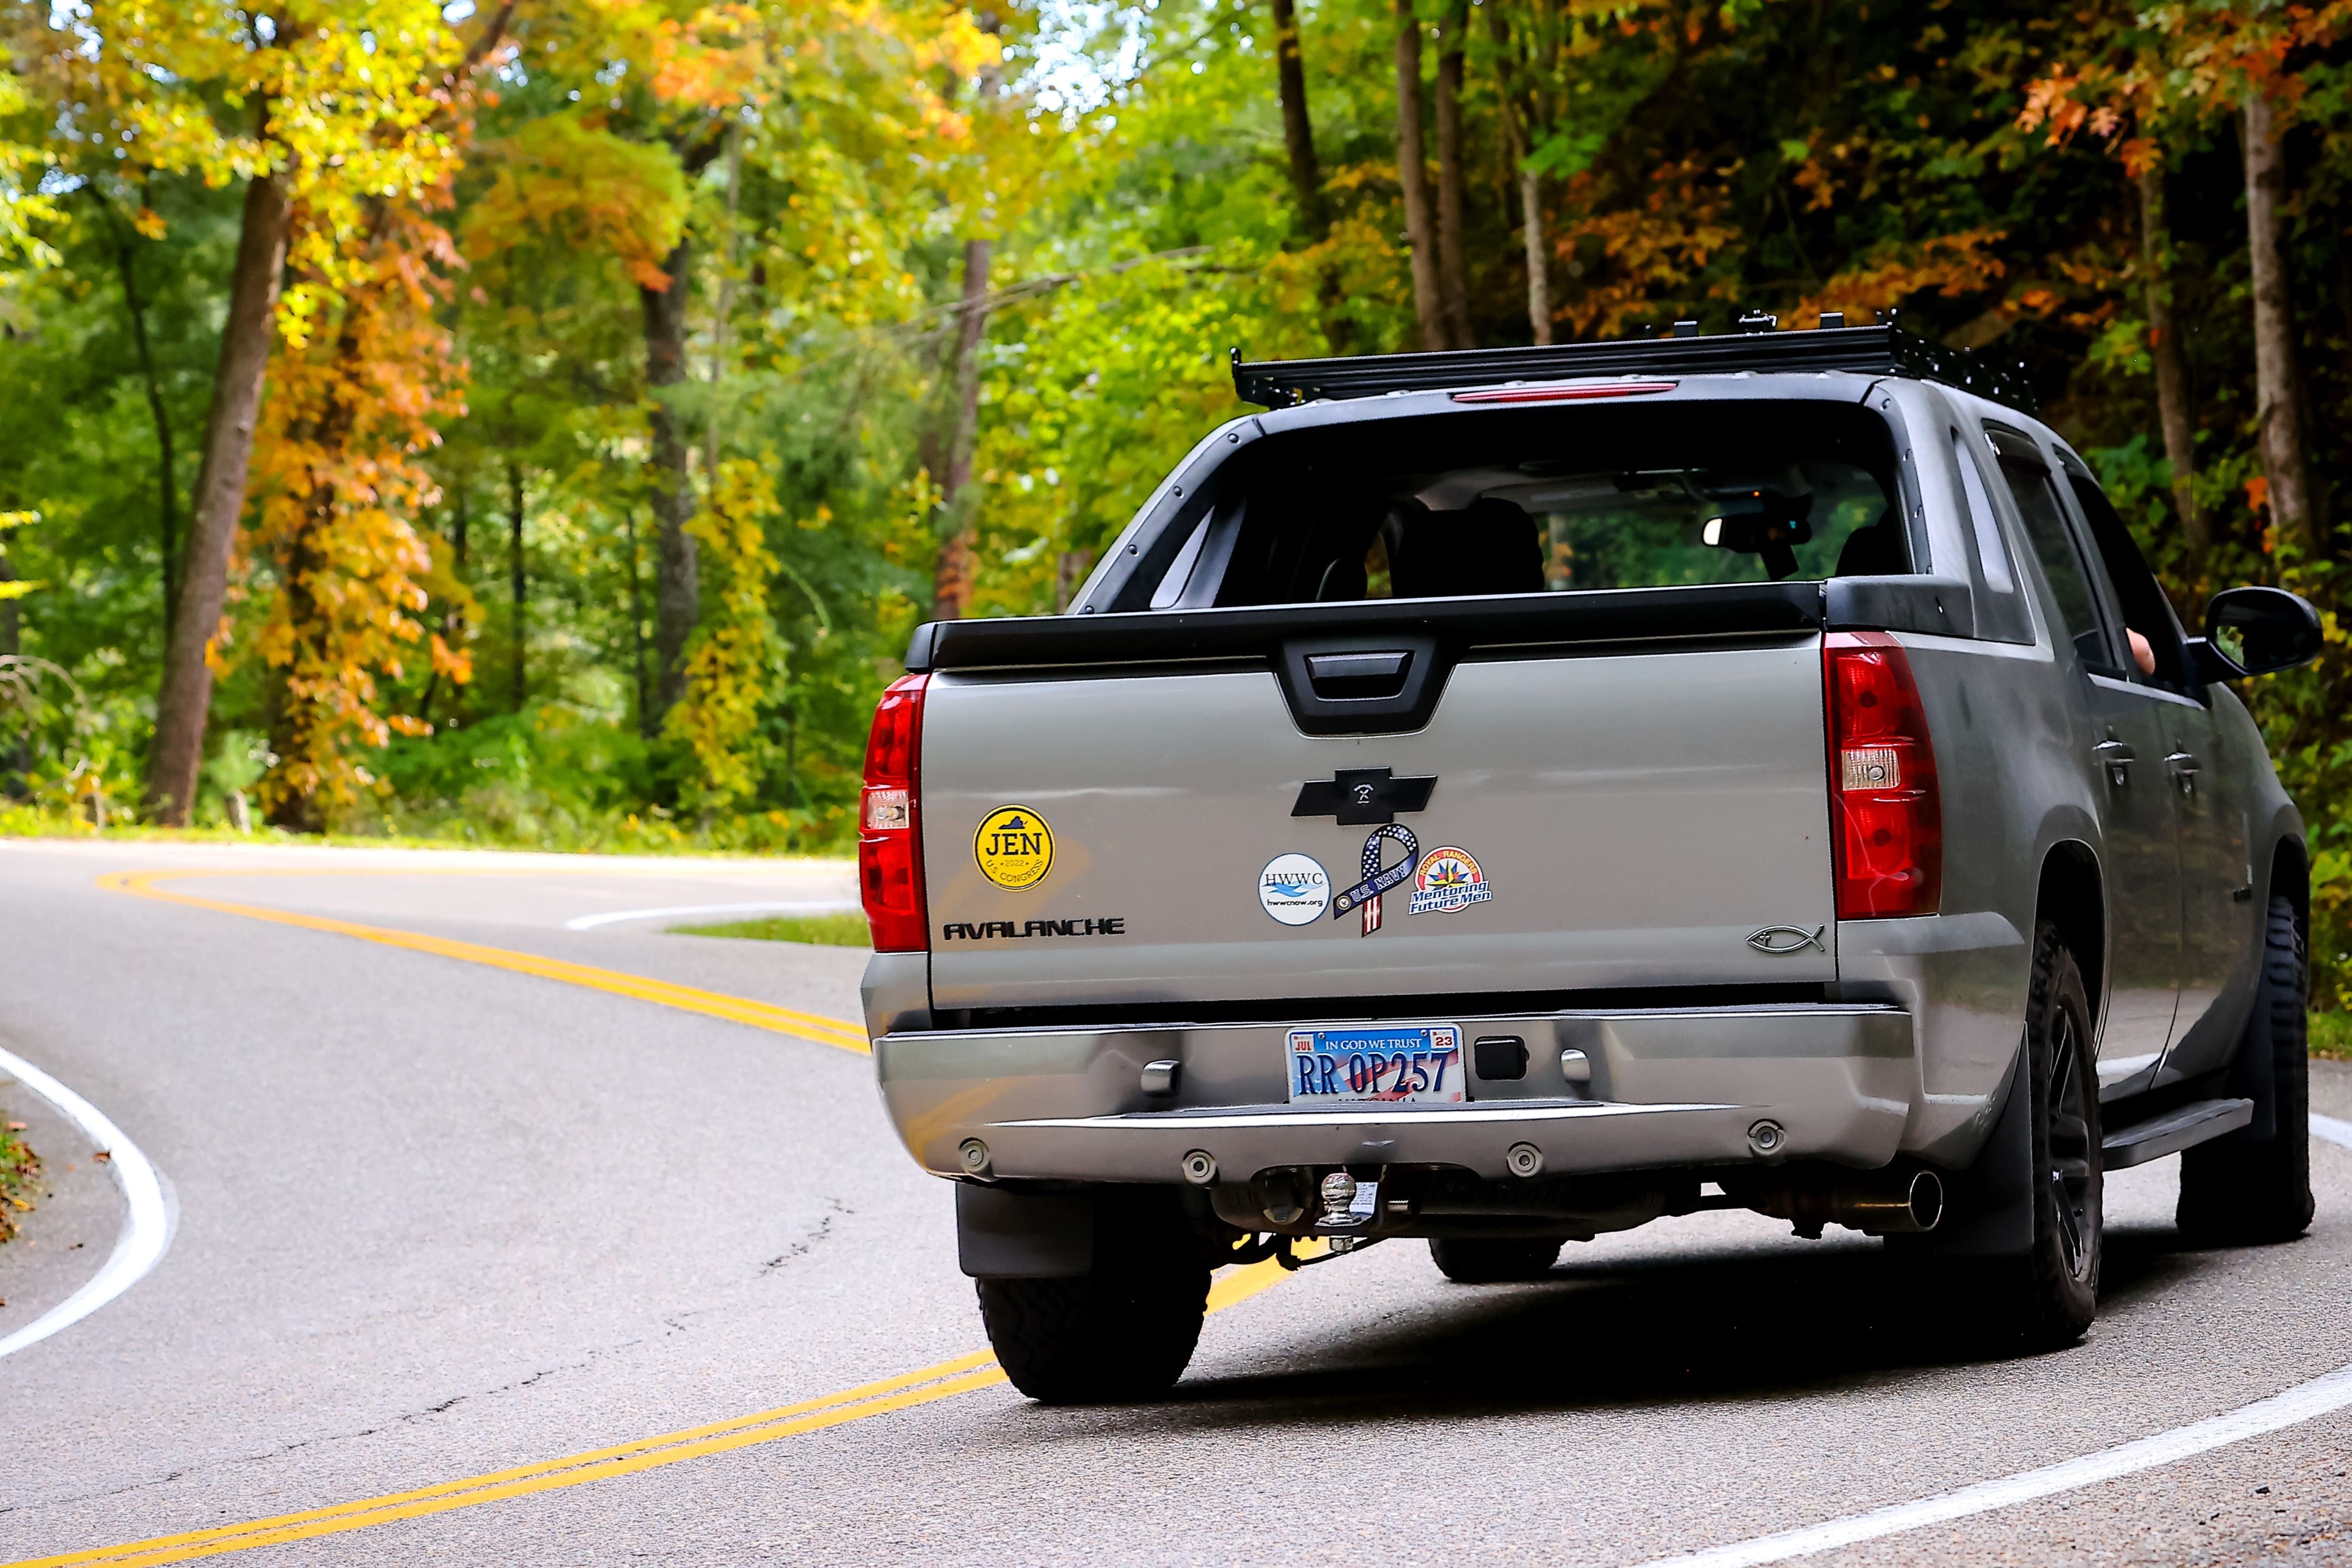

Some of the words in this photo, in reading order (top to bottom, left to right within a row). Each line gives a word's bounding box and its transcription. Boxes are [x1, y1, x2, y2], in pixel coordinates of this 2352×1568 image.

[986, 833, 1042, 856] JEN
[1000, 860, 1043, 882] CONGRESS
[1420, 853, 1441, 876] ROYAL
[1442, 851, 1478, 875] RANGERS
[1265, 873, 1323, 886] HWWC
[1350, 884, 1374, 902] U.S.
[1374, 865, 1406, 890] NAVY
[1411, 896, 1459, 913] Future
[1461, 892, 1490, 903] Men
[1413, 882, 1487, 902] Mentoring
[943, 917, 1125, 940] AVALANCHE
[1295, 1041, 1311, 1051] JUL
[1326, 1041, 1338, 1050] IN
[1341, 1040, 1367, 1050] GOD
[1368, 1039, 1386, 1049] WE
[1387, 1038, 1422, 1049] TRUST
[1435, 1036, 1453, 1046] 23
[1296, 1052, 1339, 1095] RR
